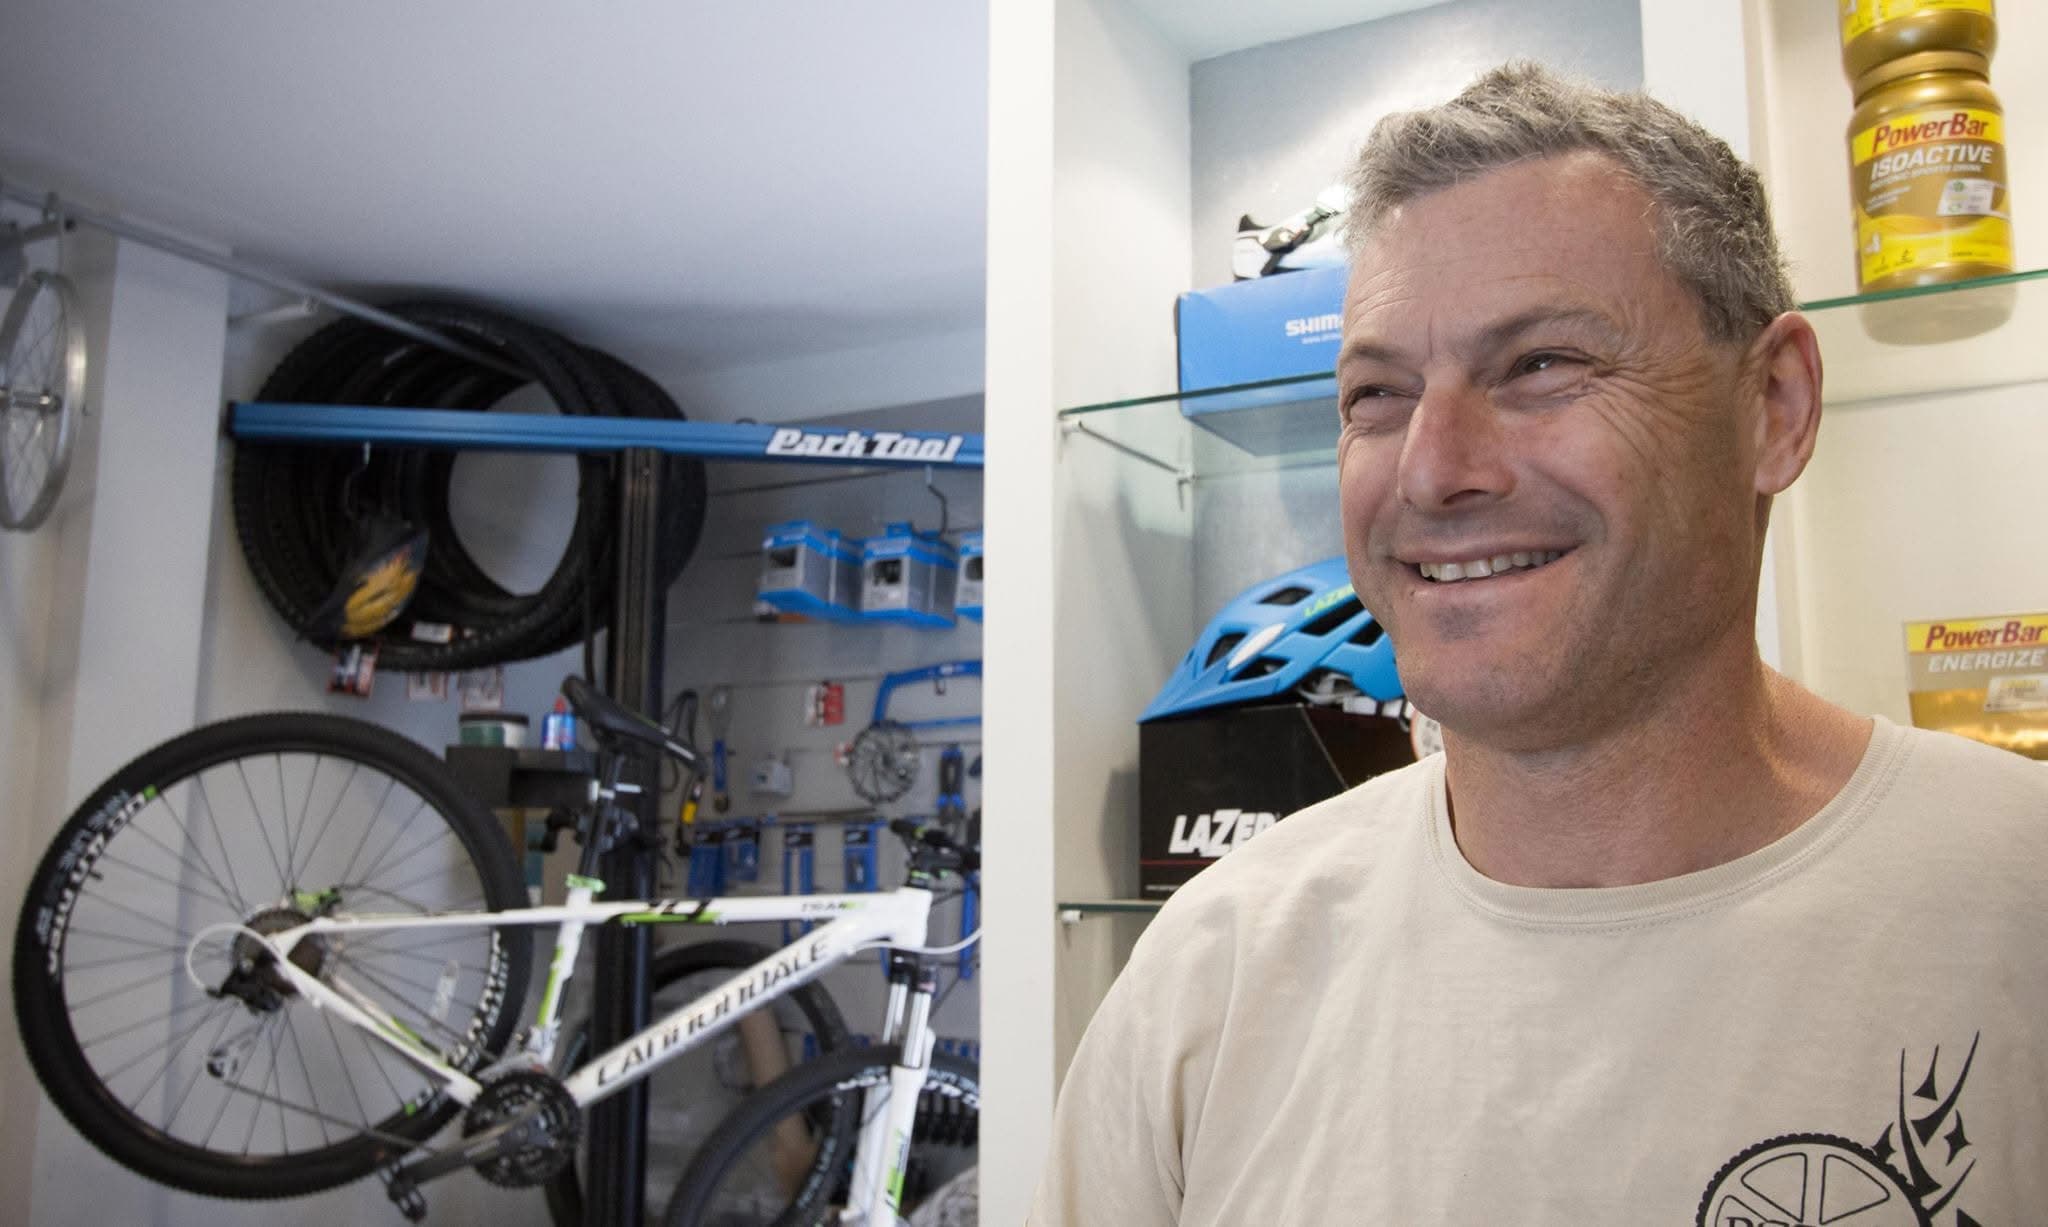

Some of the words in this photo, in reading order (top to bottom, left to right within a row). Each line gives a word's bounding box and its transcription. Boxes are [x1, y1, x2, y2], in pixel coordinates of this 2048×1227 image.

[1872, 112, 1989, 153] PowerBar
[1871, 144, 1993, 180] ISOACTIVE
[1925, 621, 2048, 649] PowerBar
[1928, 651, 2045, 672] ENERGIZE
